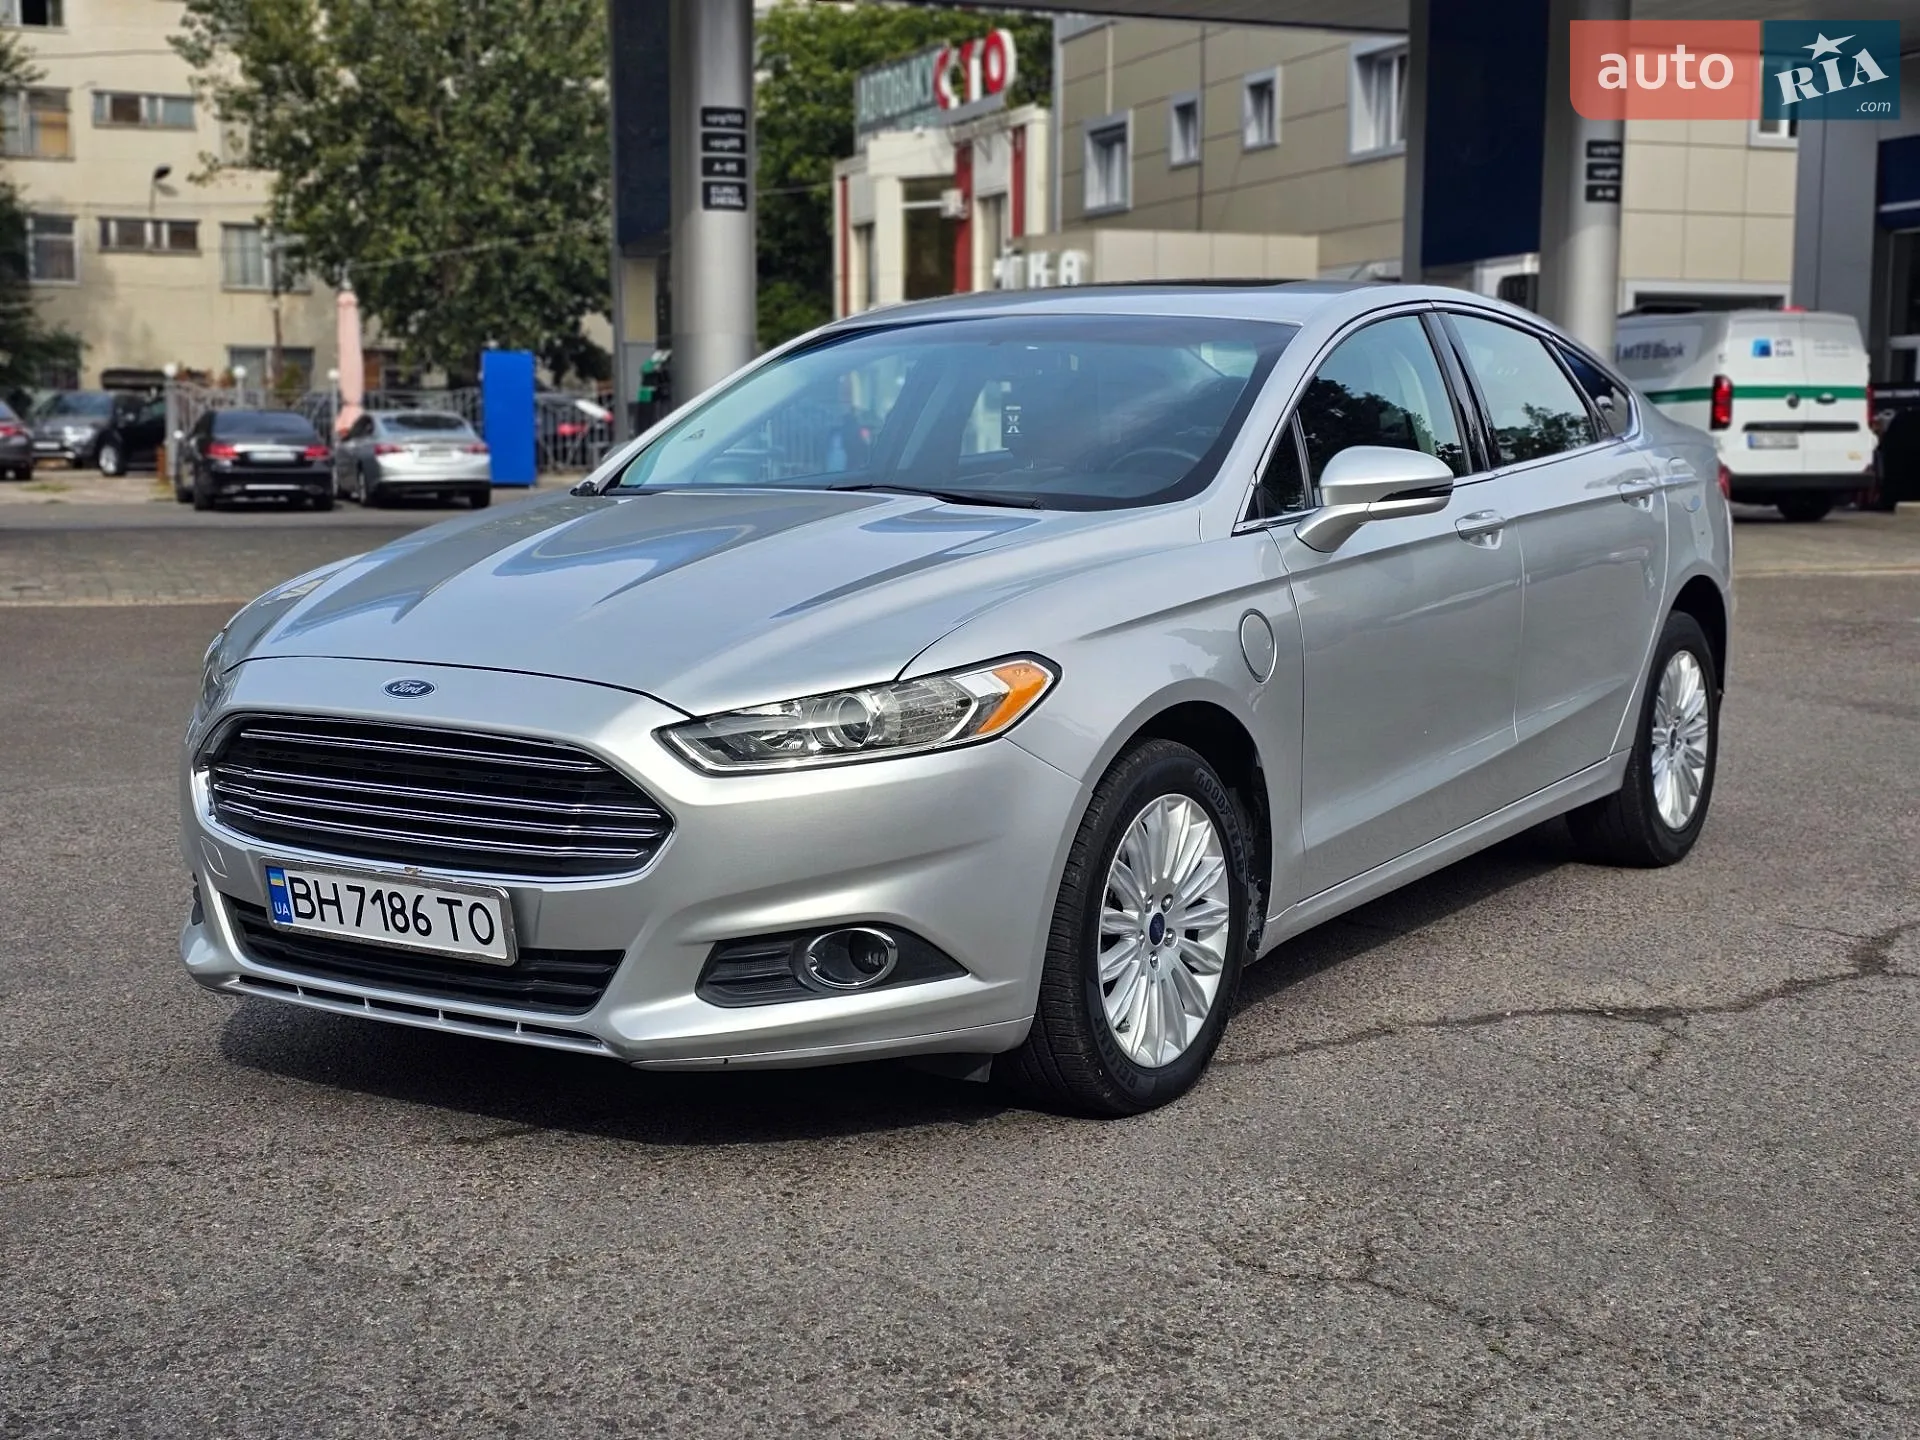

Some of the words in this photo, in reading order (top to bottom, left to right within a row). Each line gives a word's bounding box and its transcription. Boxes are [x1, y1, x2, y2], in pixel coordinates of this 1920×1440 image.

[934, 28, 1015, 110] СТО
[392, 680, 426, 694] Ford
[274, 902, 290, 917] UA
[436, 896, 495, 946] TO
